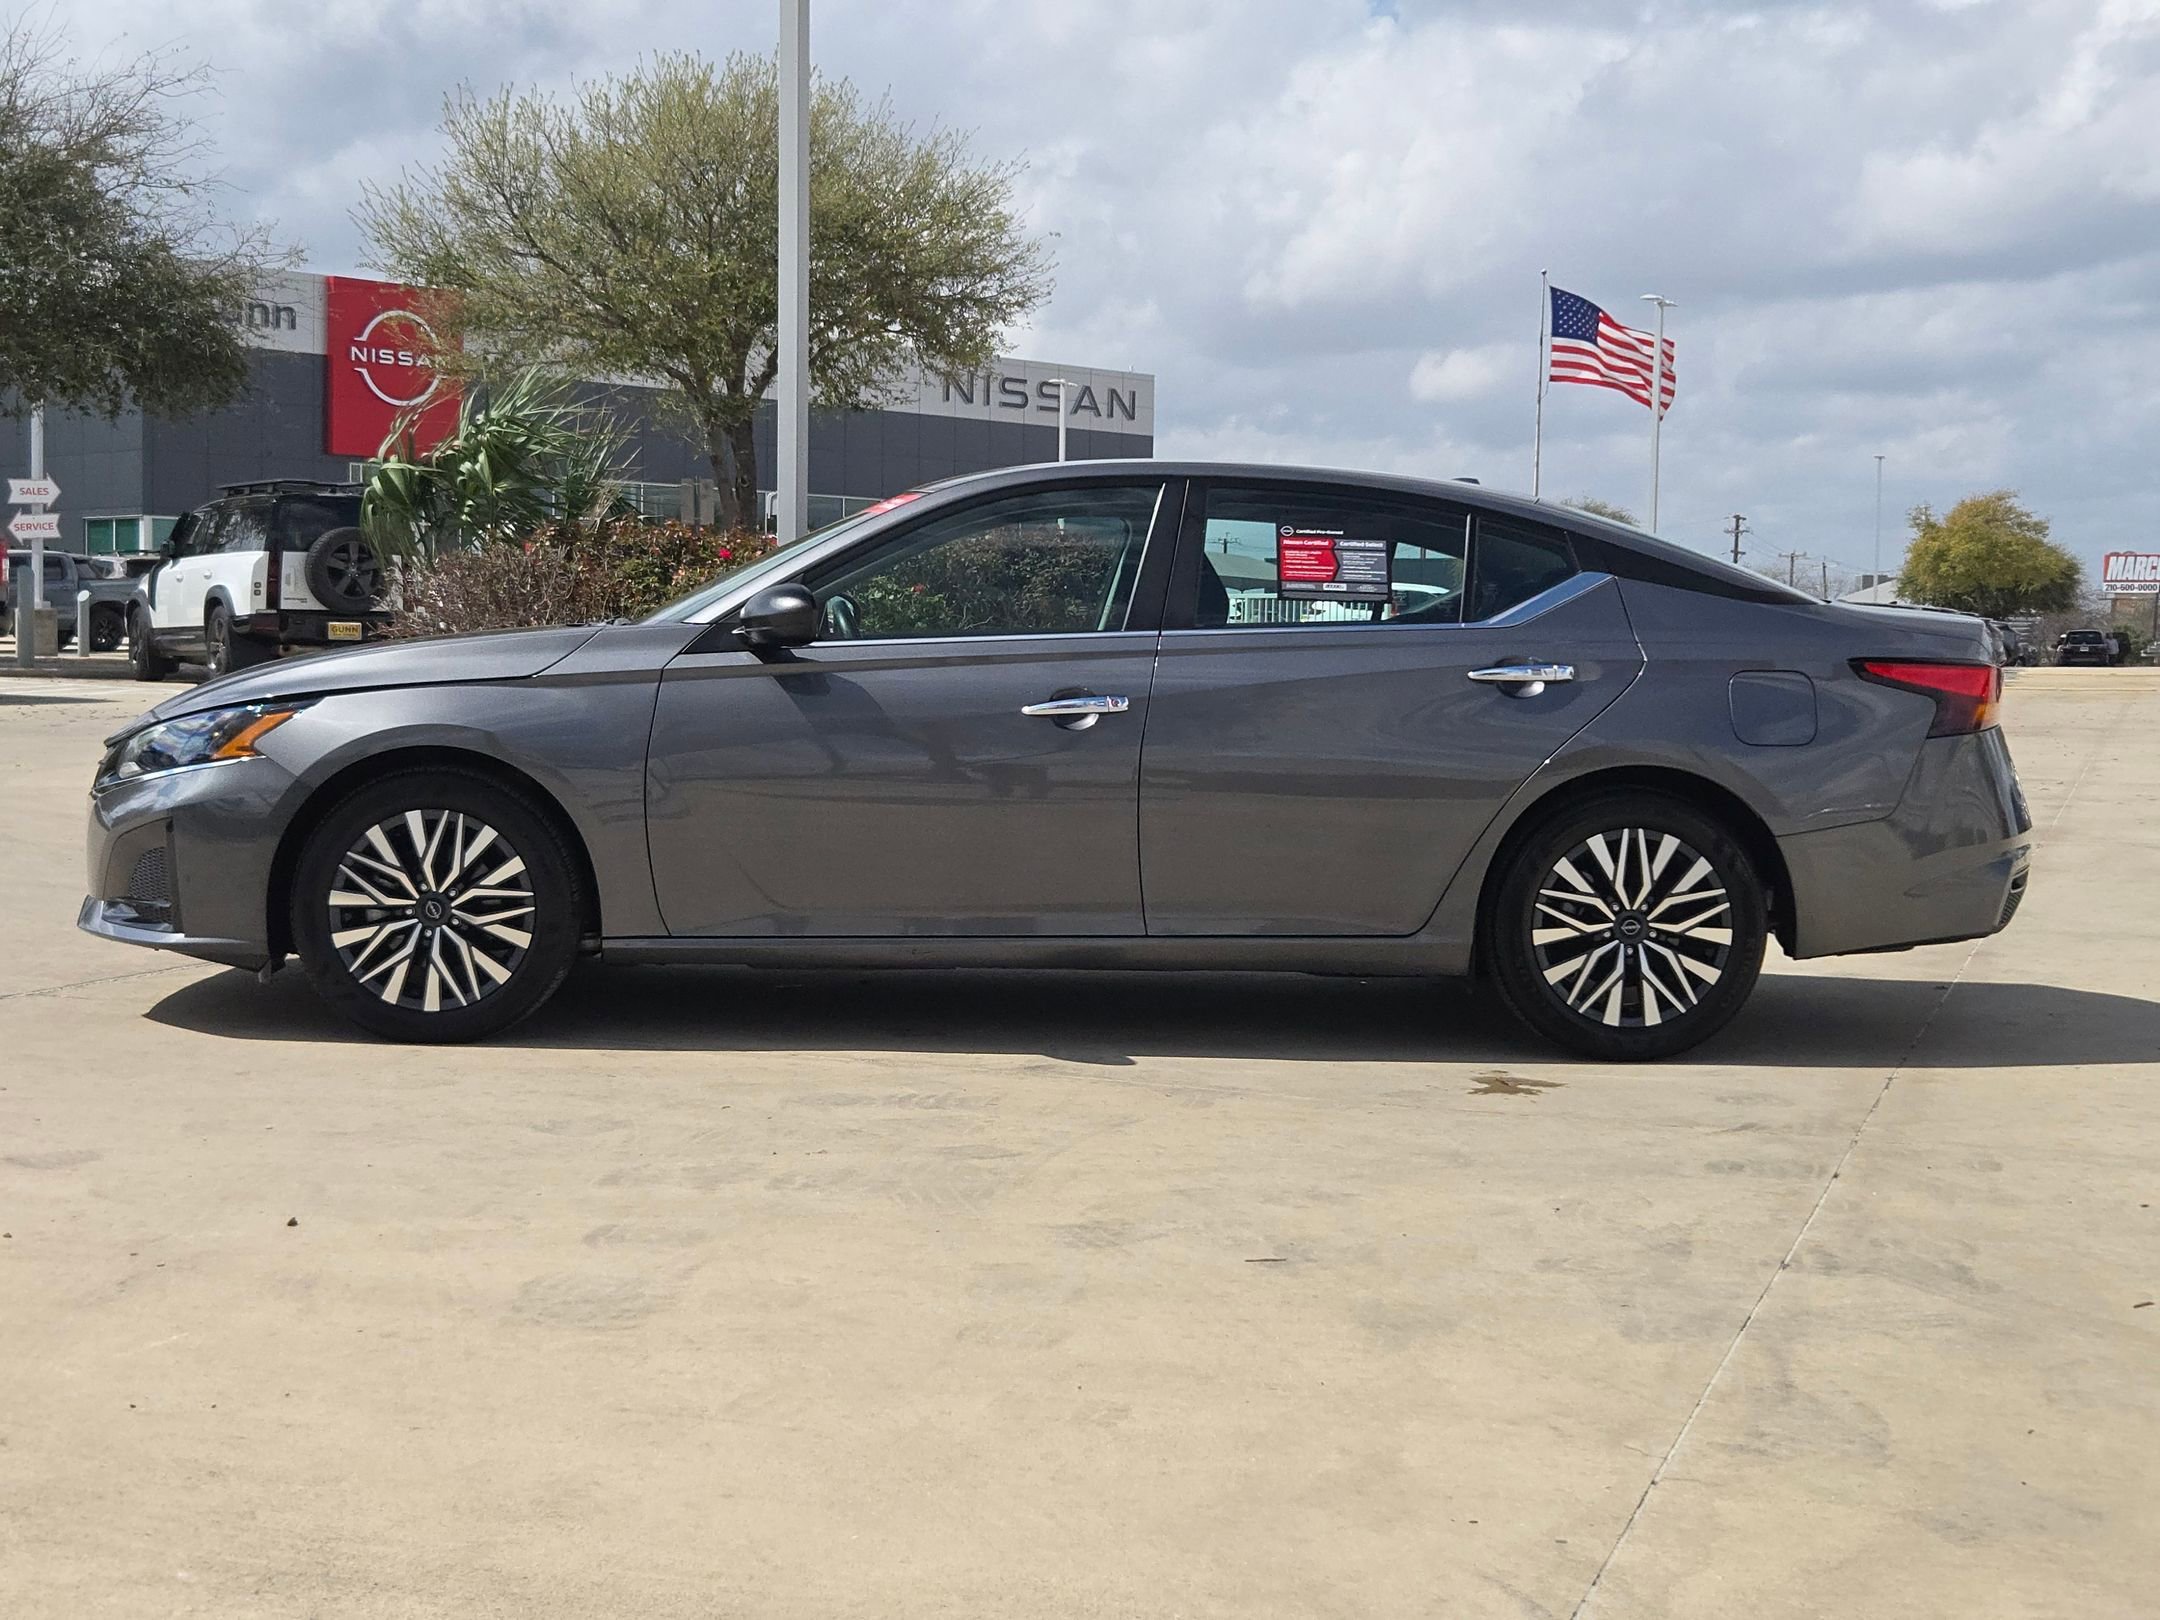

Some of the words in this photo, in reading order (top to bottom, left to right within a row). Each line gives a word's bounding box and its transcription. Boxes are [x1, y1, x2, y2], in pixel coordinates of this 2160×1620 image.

[942, 370, 1136, 421] NISSAN
[20, 487, 49, 496] SALES
[14, 522, 55, 532] SERVICE
[2106, 556, 2160, 580] MARC
[330, 625, 359, 633] GUNN
